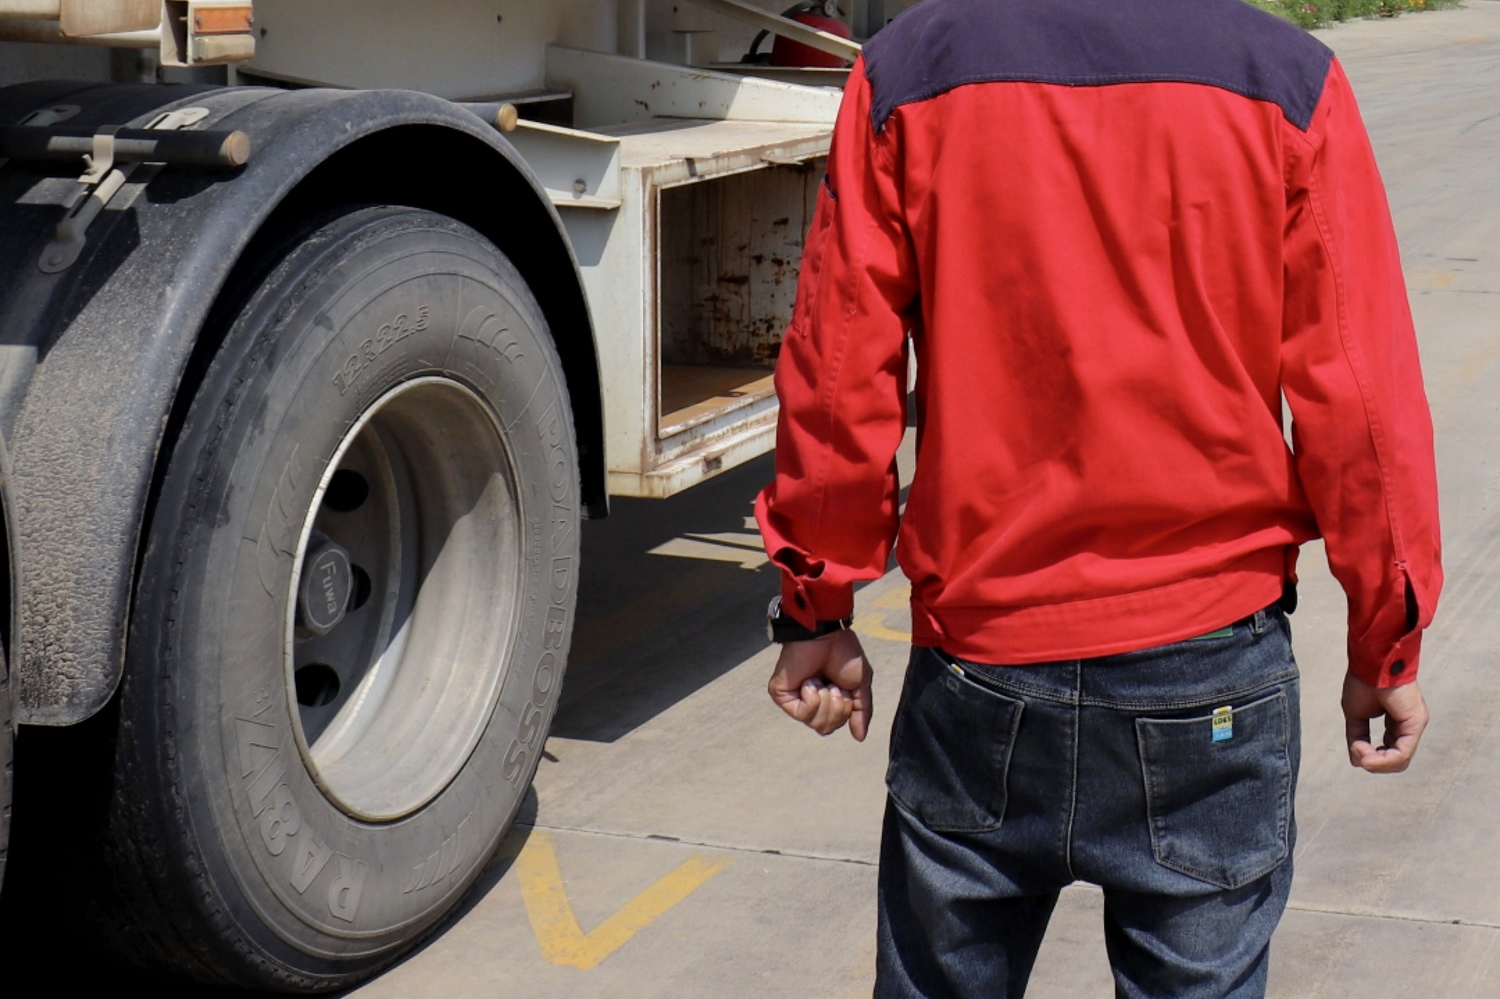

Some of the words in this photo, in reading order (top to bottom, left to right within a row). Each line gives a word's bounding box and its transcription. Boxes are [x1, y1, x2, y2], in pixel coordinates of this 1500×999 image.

[330, 303, 430, 397] 12R22.5
[320, 560, 338, 615] Fuwa
[502, 404, 574, 793] ROADBOSS
